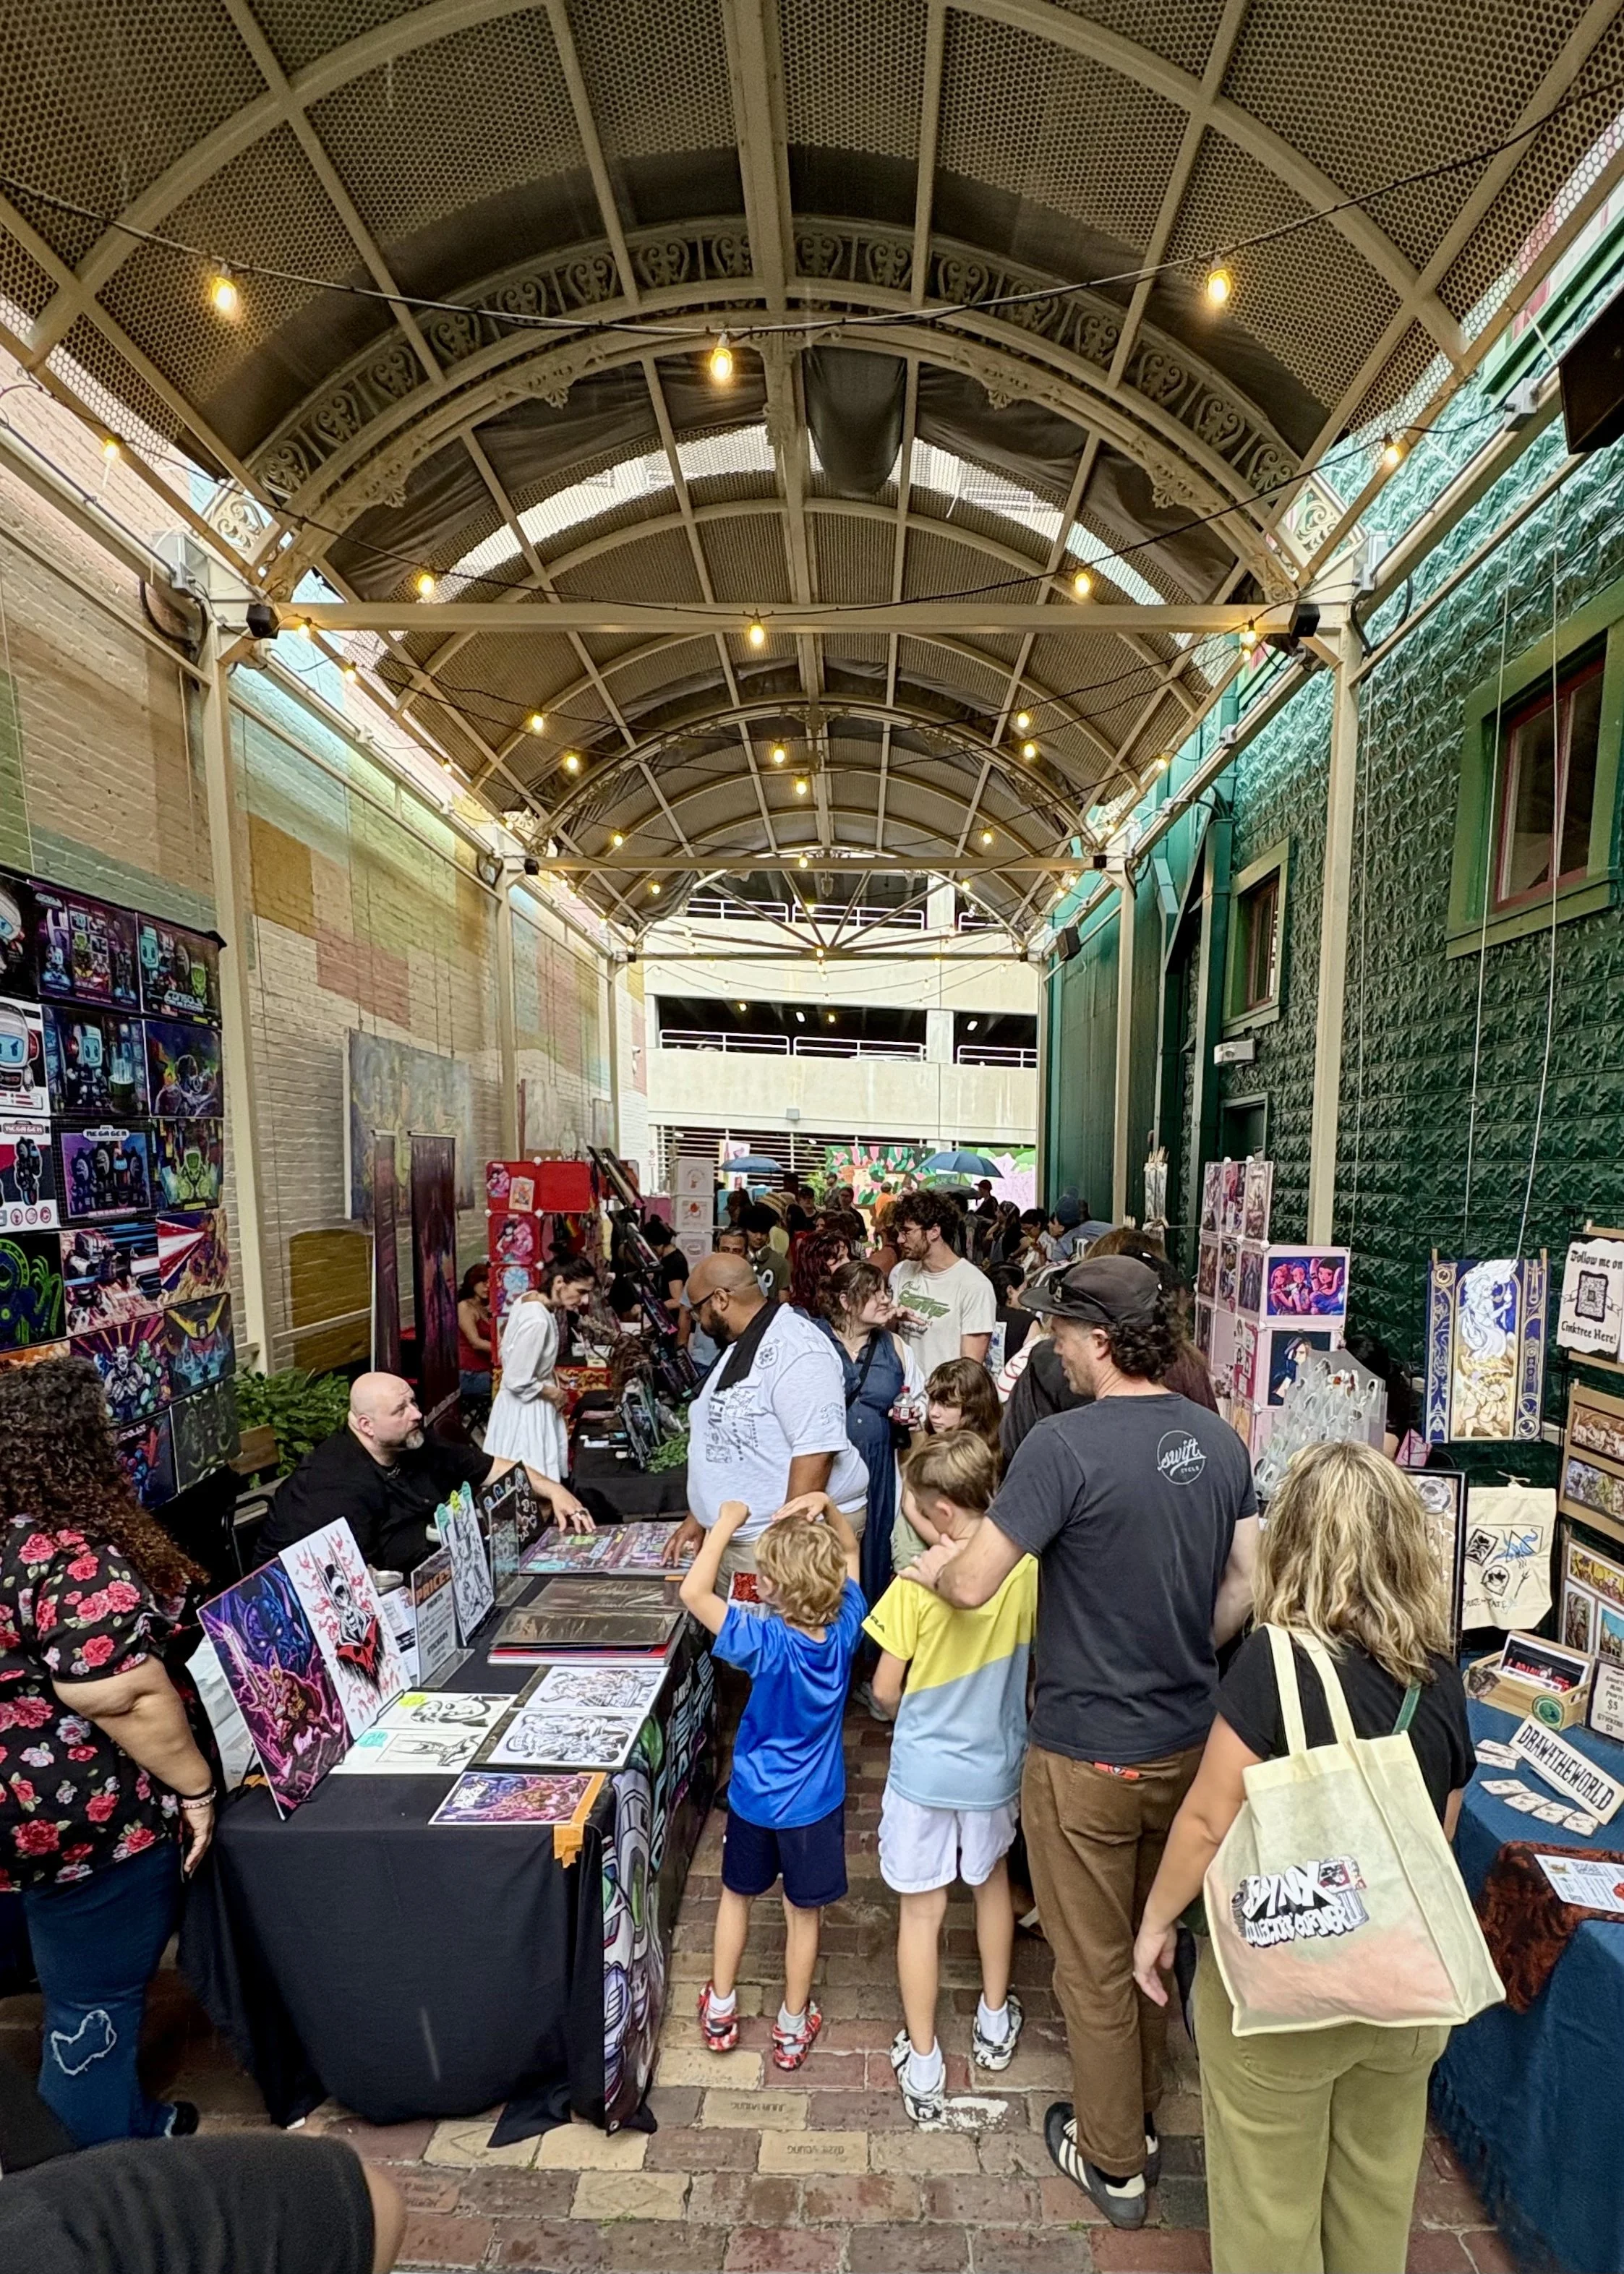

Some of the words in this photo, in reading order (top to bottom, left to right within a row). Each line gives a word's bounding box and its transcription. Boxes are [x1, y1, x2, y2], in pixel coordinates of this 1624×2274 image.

[1570, 1250, 1597, 1265] Follow
[1599, 1258, 1610, 1268] me
[1612, 1260, 1623, 1270] on
[1594, 1329, 1617, 1344] Here!
[1157, 1437, 1207, 1471] swift
[1607, 1699, 1618, 1711] $5
